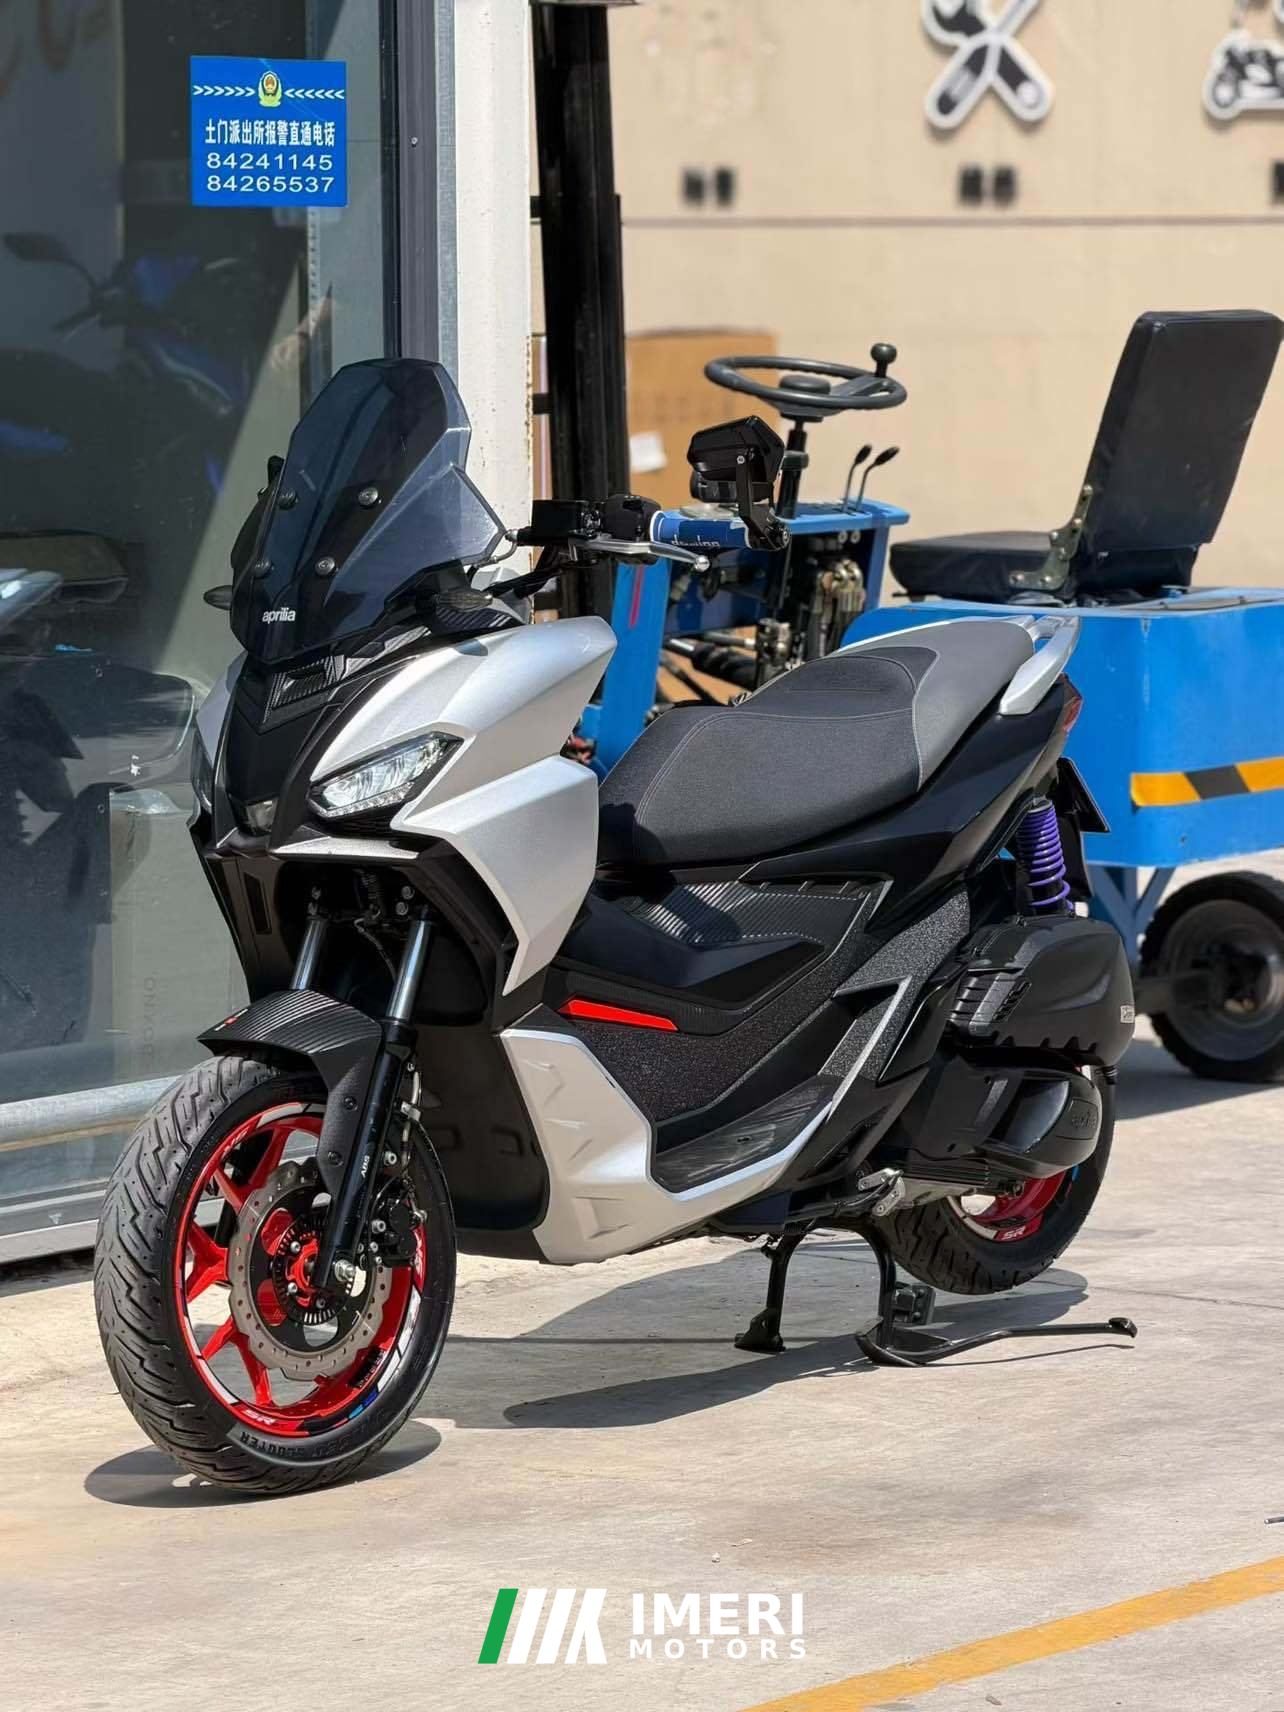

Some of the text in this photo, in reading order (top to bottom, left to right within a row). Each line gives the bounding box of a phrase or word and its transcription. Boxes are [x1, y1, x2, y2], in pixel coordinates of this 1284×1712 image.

[205, 118, 335, 147] 土门派出所报警直通电话
[206, 152, 333, 170] 84241145
[206, 175, 335, 193] 84265537
[262, 606, 296, 624] aprilia
